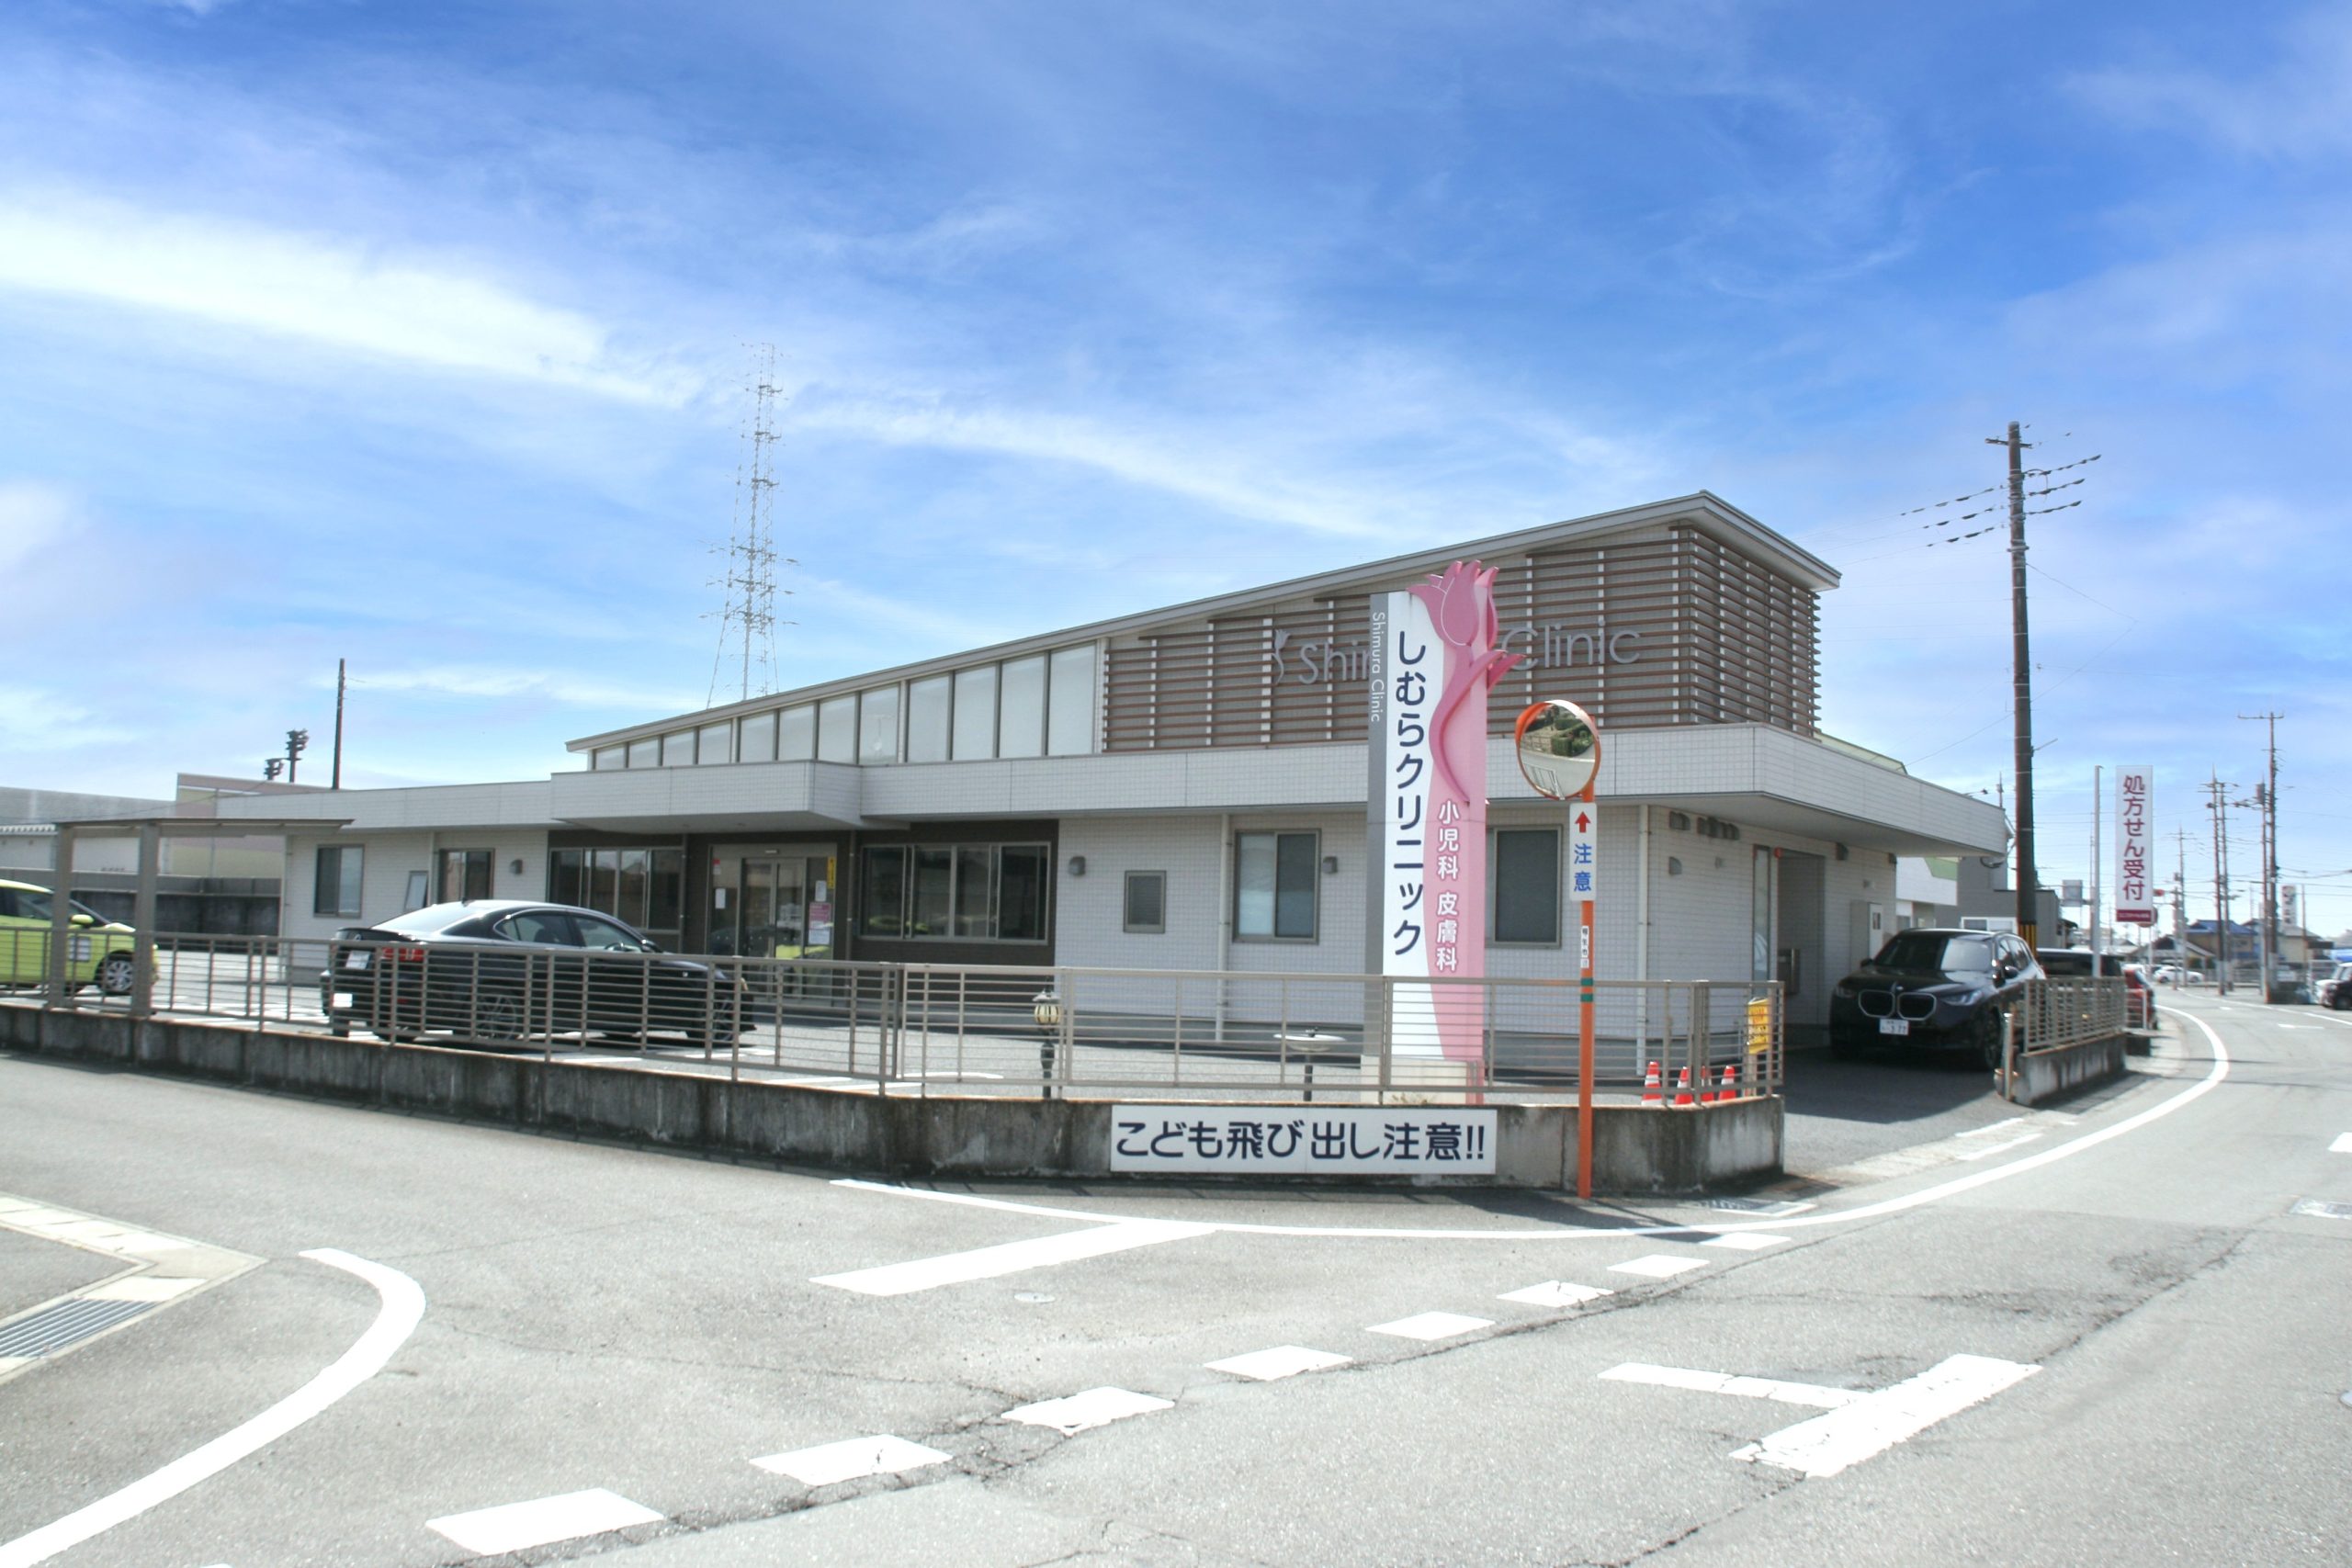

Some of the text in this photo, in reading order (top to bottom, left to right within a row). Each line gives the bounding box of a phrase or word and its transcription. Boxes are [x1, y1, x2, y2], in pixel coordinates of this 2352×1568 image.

[1371, 612, 1385, 722] Shimura Clinic
[1501, 620, 1640, 671] Clinic
[1393, 630, 1426, 955] しむらクリニック
[2122, 774, 2145, 901] 処方せん受付
[1435, 799, 1459, 972] 小児科 皮膚科
[1574, 842, 1591, 892] 注意
[1116, 1120, 1485, 1160] こども飛び出し注意!!
